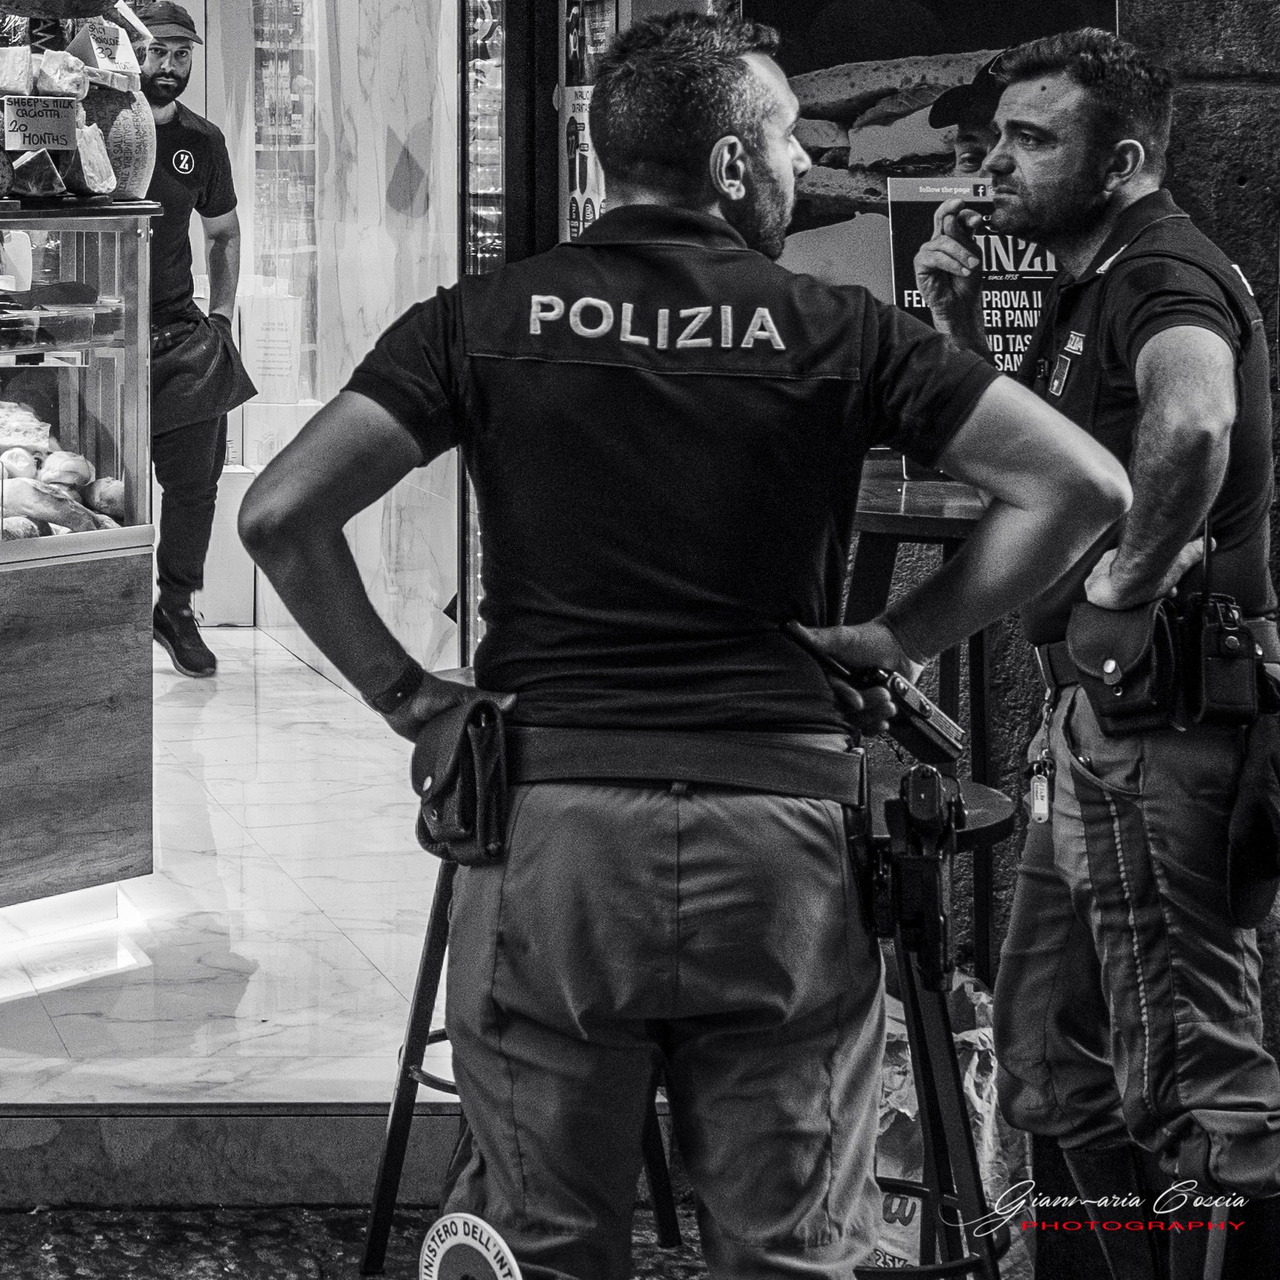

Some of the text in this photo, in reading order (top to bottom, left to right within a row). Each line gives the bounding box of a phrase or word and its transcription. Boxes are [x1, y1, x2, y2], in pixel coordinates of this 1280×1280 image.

[96, 47, 116, 60] 32
[22, 134, 68, 146] MONTHS
[179, 153, 189, 171] Z
[919, 186, 940, 194] follow
[972, 235, 1059, 272] INZI
[982, 290, 1030, 308] PROVA
[529, 294, 787, 350] POLIZIA
